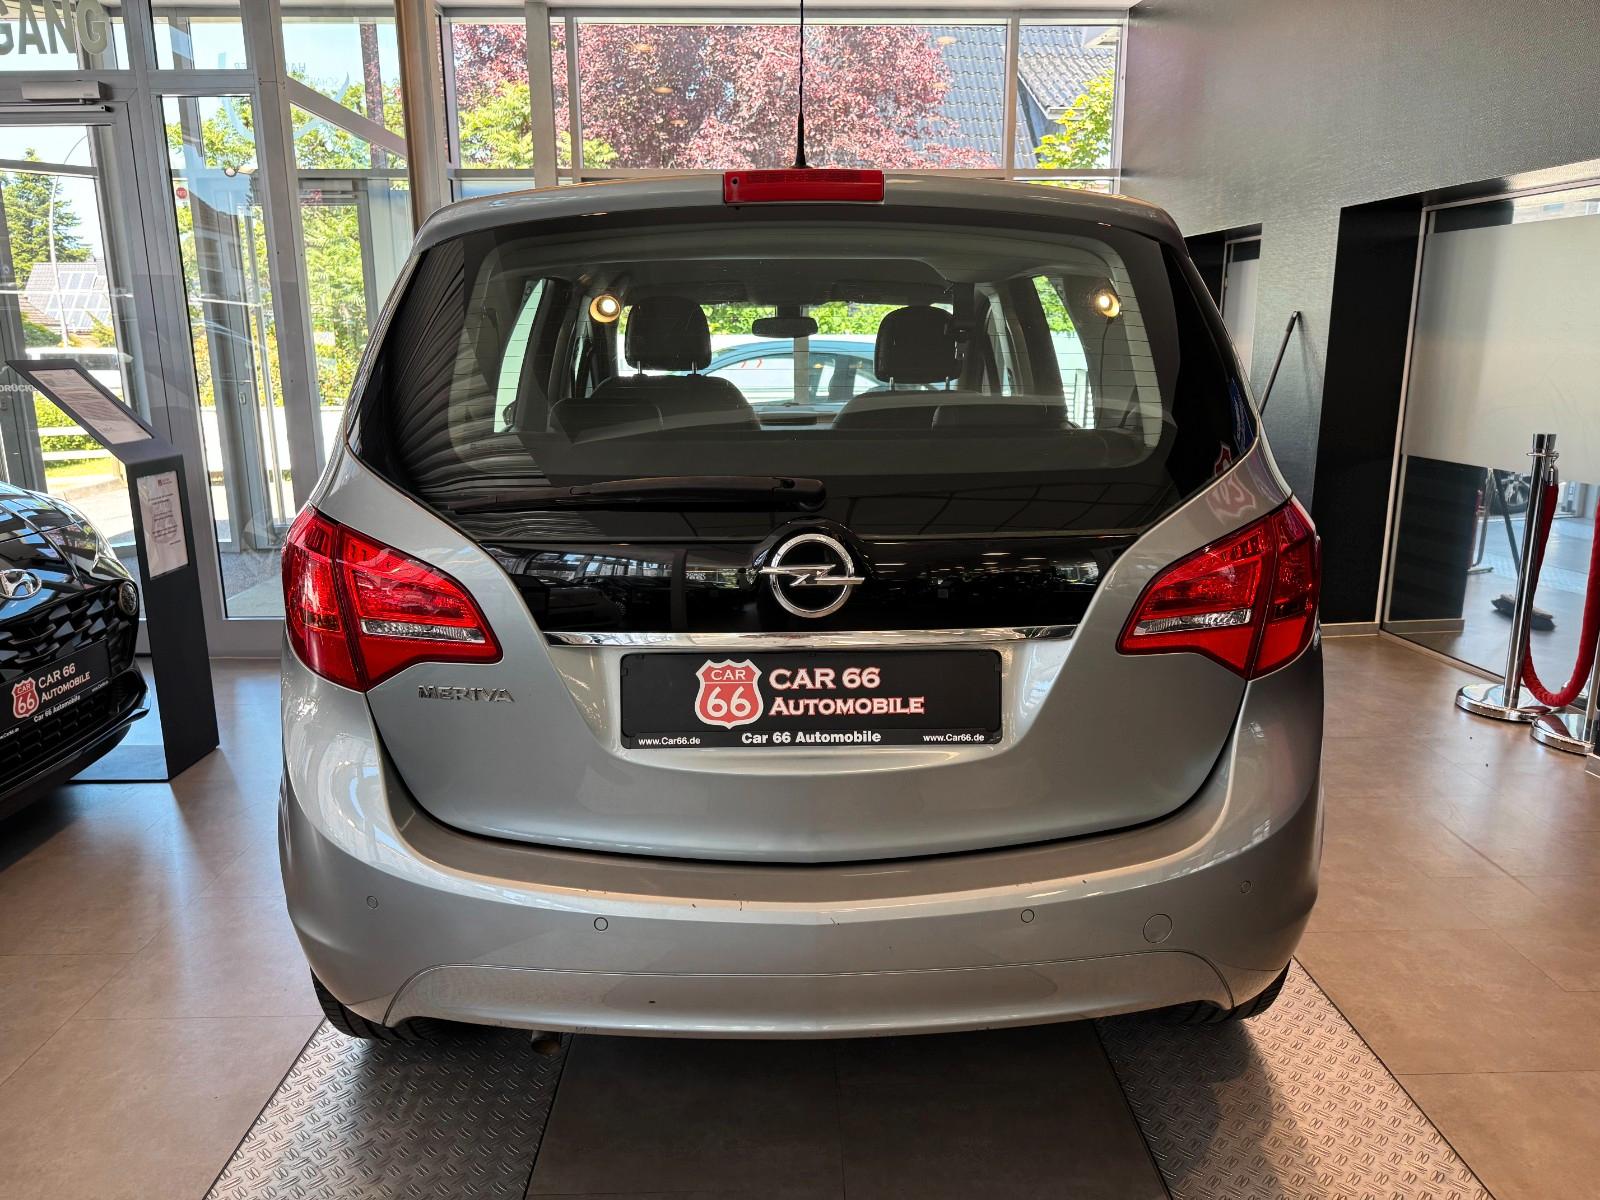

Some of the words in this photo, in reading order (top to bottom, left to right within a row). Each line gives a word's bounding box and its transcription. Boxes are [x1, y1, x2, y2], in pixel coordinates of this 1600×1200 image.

[38, 670, 62, 688] CAR
[62, 663, 76, 677] 66
[711, 669, 746, 681] CAR
[768, 668, 836, 690] CAR
[842, 667, 881, 689] 66
[17, 683, 31, 694] CAR
[41, 672, 91, 703] AUTOMOBILE
[18, 692, 35, 713] 66
[706, 686, 751, 717] 66
[768, 696, 925, 716] AUTOMOBILE
[638, 737, 701, 745] www.Car66.de
[741, 732, 768, 744] Car
[772, 732, 791, 743] 66
[795, 730, 882, 743] Automobile
[923, 733, 985, 742] www.Car66.de
